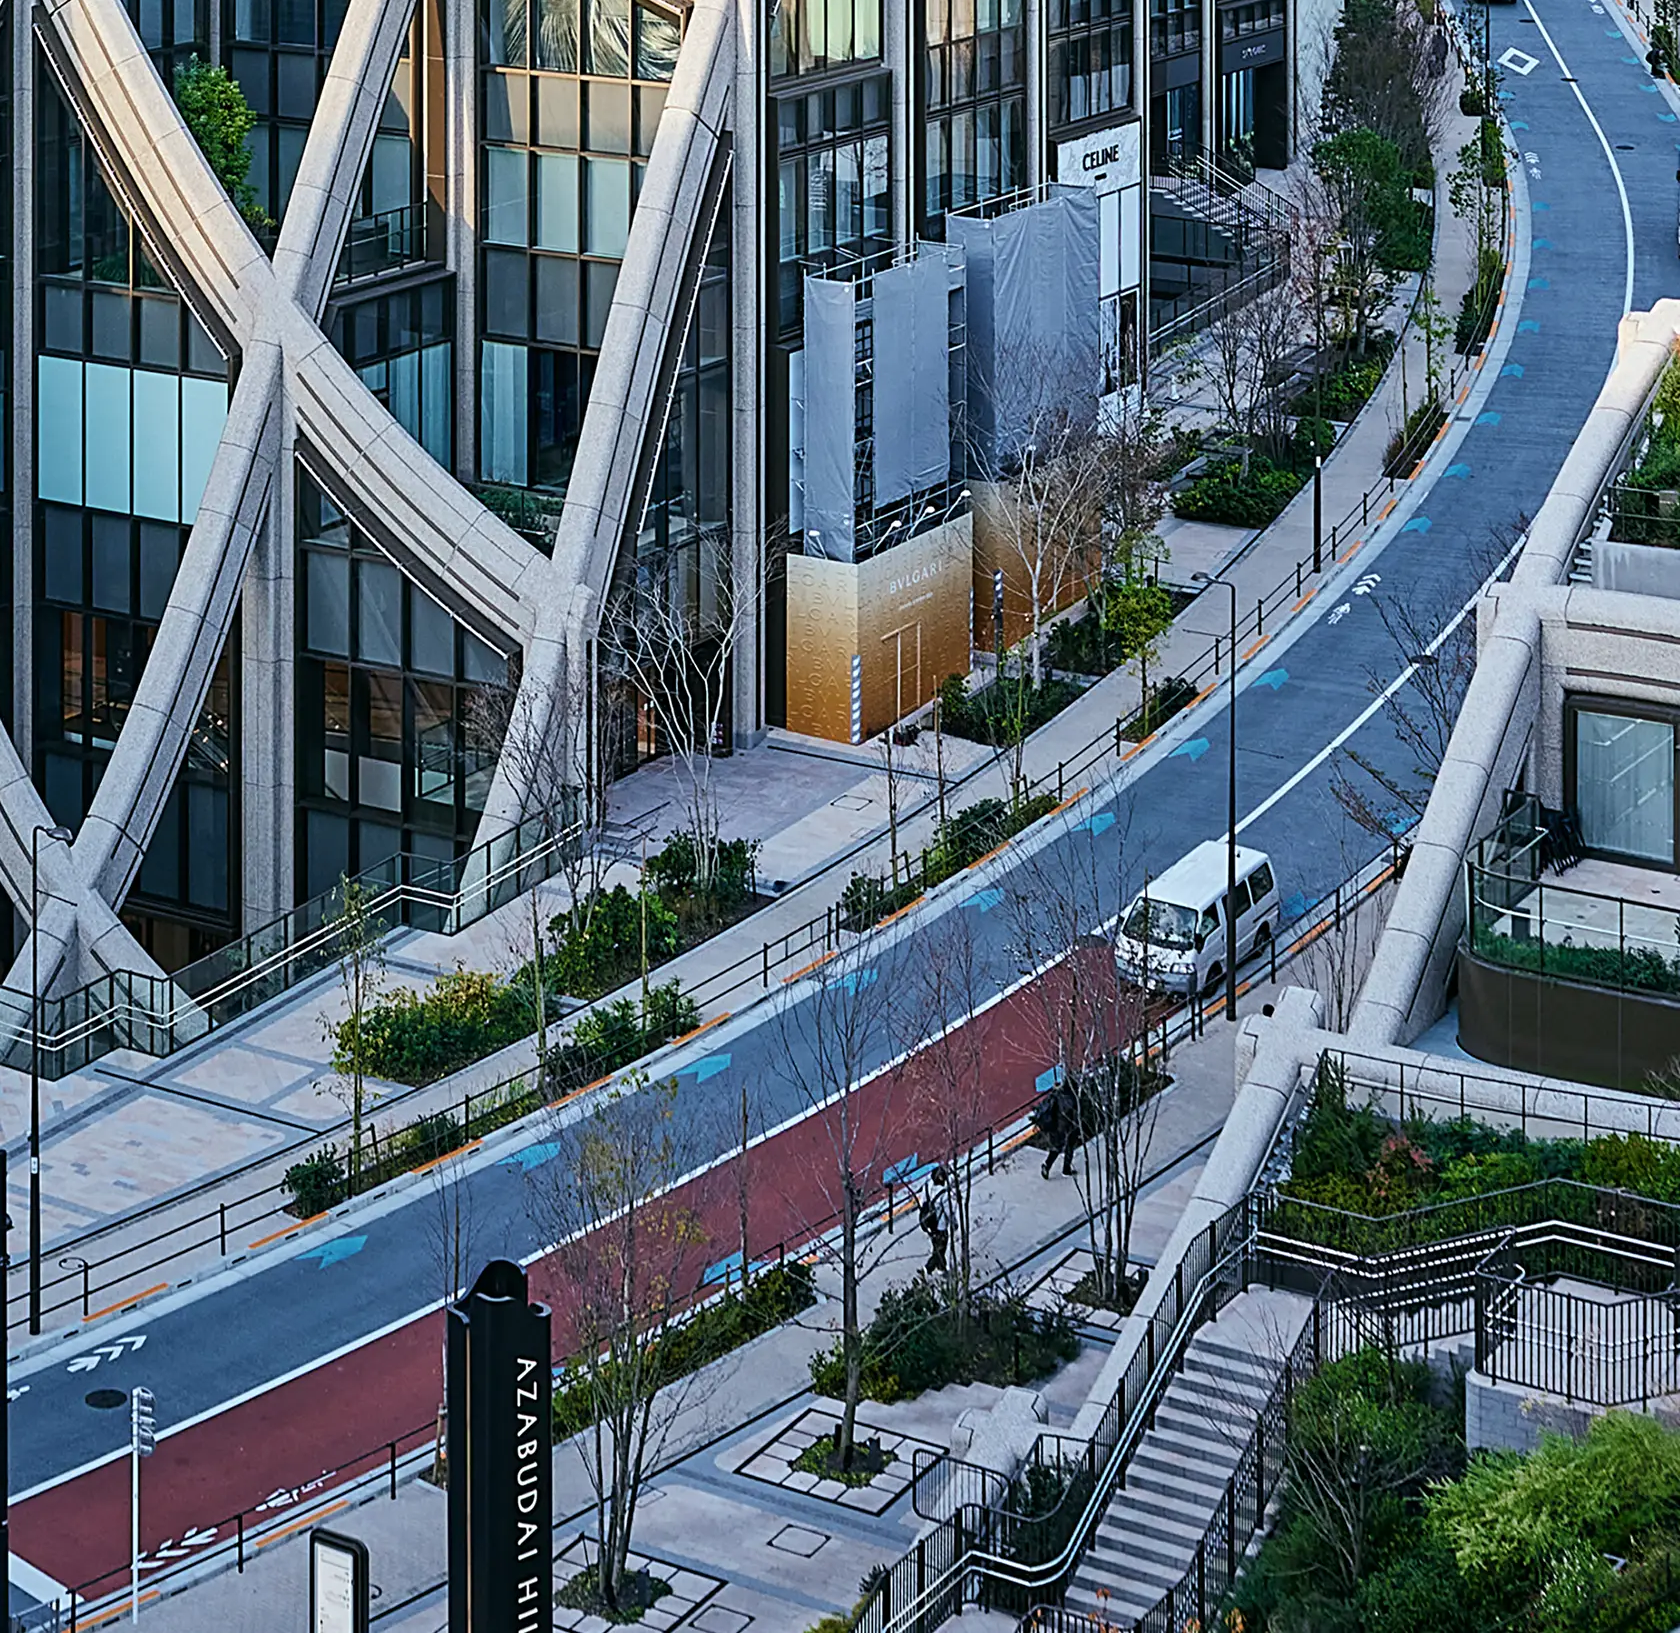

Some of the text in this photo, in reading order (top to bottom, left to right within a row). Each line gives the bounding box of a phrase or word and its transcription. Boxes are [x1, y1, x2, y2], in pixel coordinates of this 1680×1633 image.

[1082, 143, 1119, 172] CELINE
[890, 559, 942, 595] BVLGARI
[516, 1357, 539, 1561] AZABUDAI
